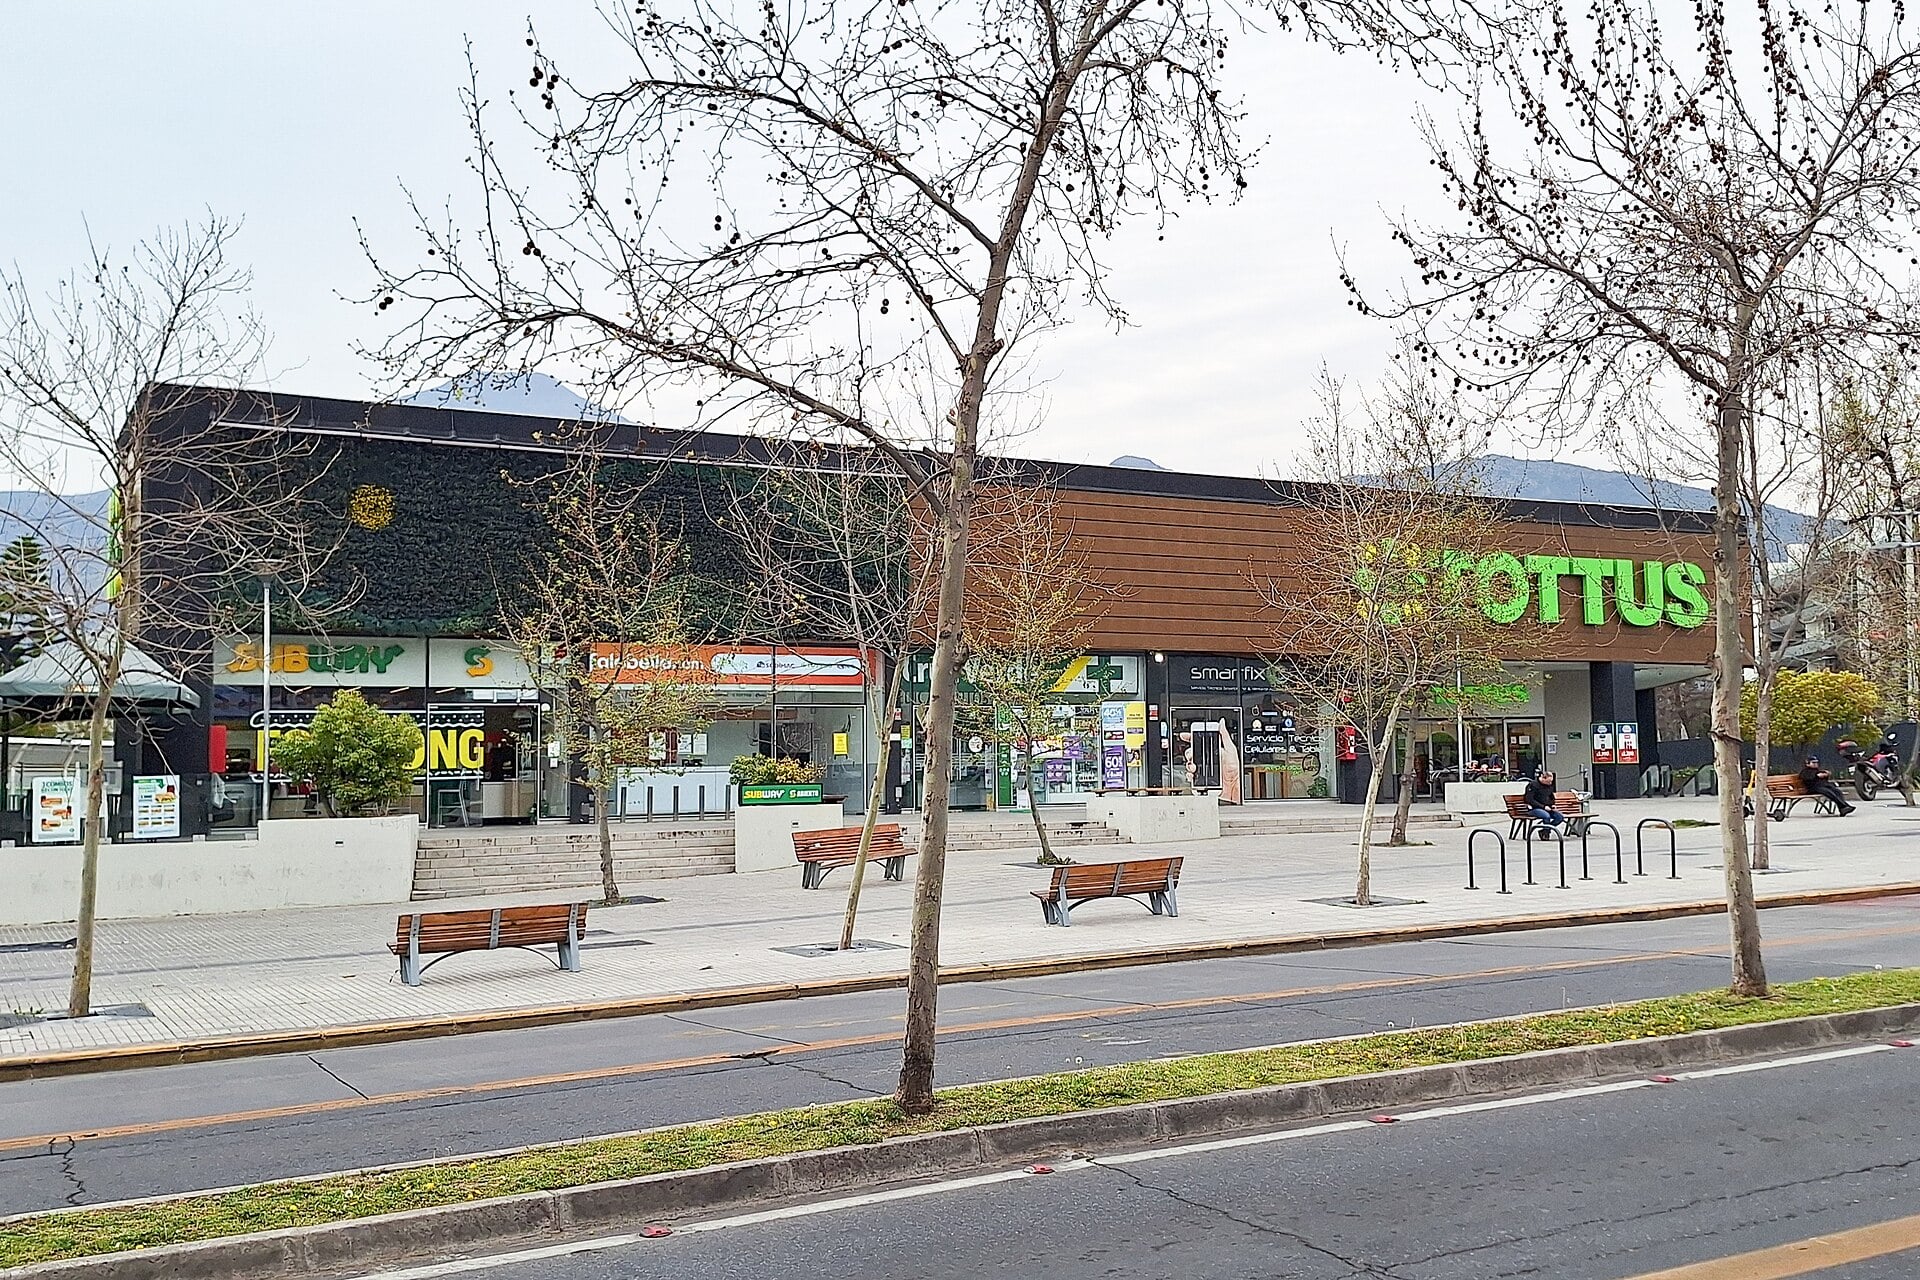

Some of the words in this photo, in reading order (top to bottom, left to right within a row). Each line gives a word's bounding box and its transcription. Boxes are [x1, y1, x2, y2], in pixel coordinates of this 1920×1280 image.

[227, 643, 405, 674] SUBWAY
[1246, 734, 1284, 743] Servicio
[1244, 745, 1287, 754] Celulares
[1288, 745, 1297, 753] &
[743, 789, 785, 799] SUBWAY
